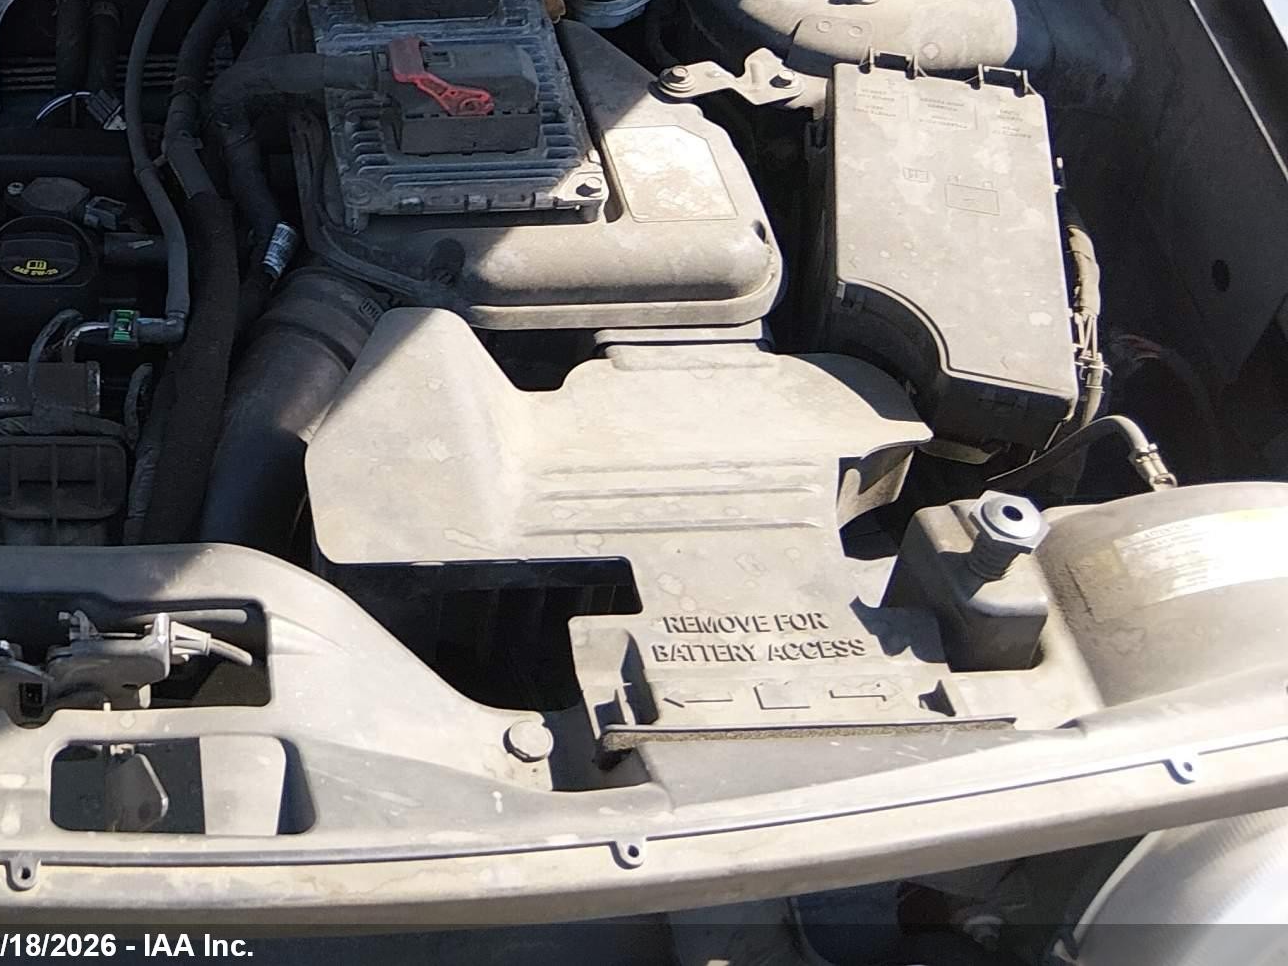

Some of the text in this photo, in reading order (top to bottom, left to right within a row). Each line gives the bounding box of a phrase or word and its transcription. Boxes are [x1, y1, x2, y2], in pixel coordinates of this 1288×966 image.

[662, 611, 830, 634] REMOVE FOR
[651, 638, 868, 663] BATTERY ACCESS
